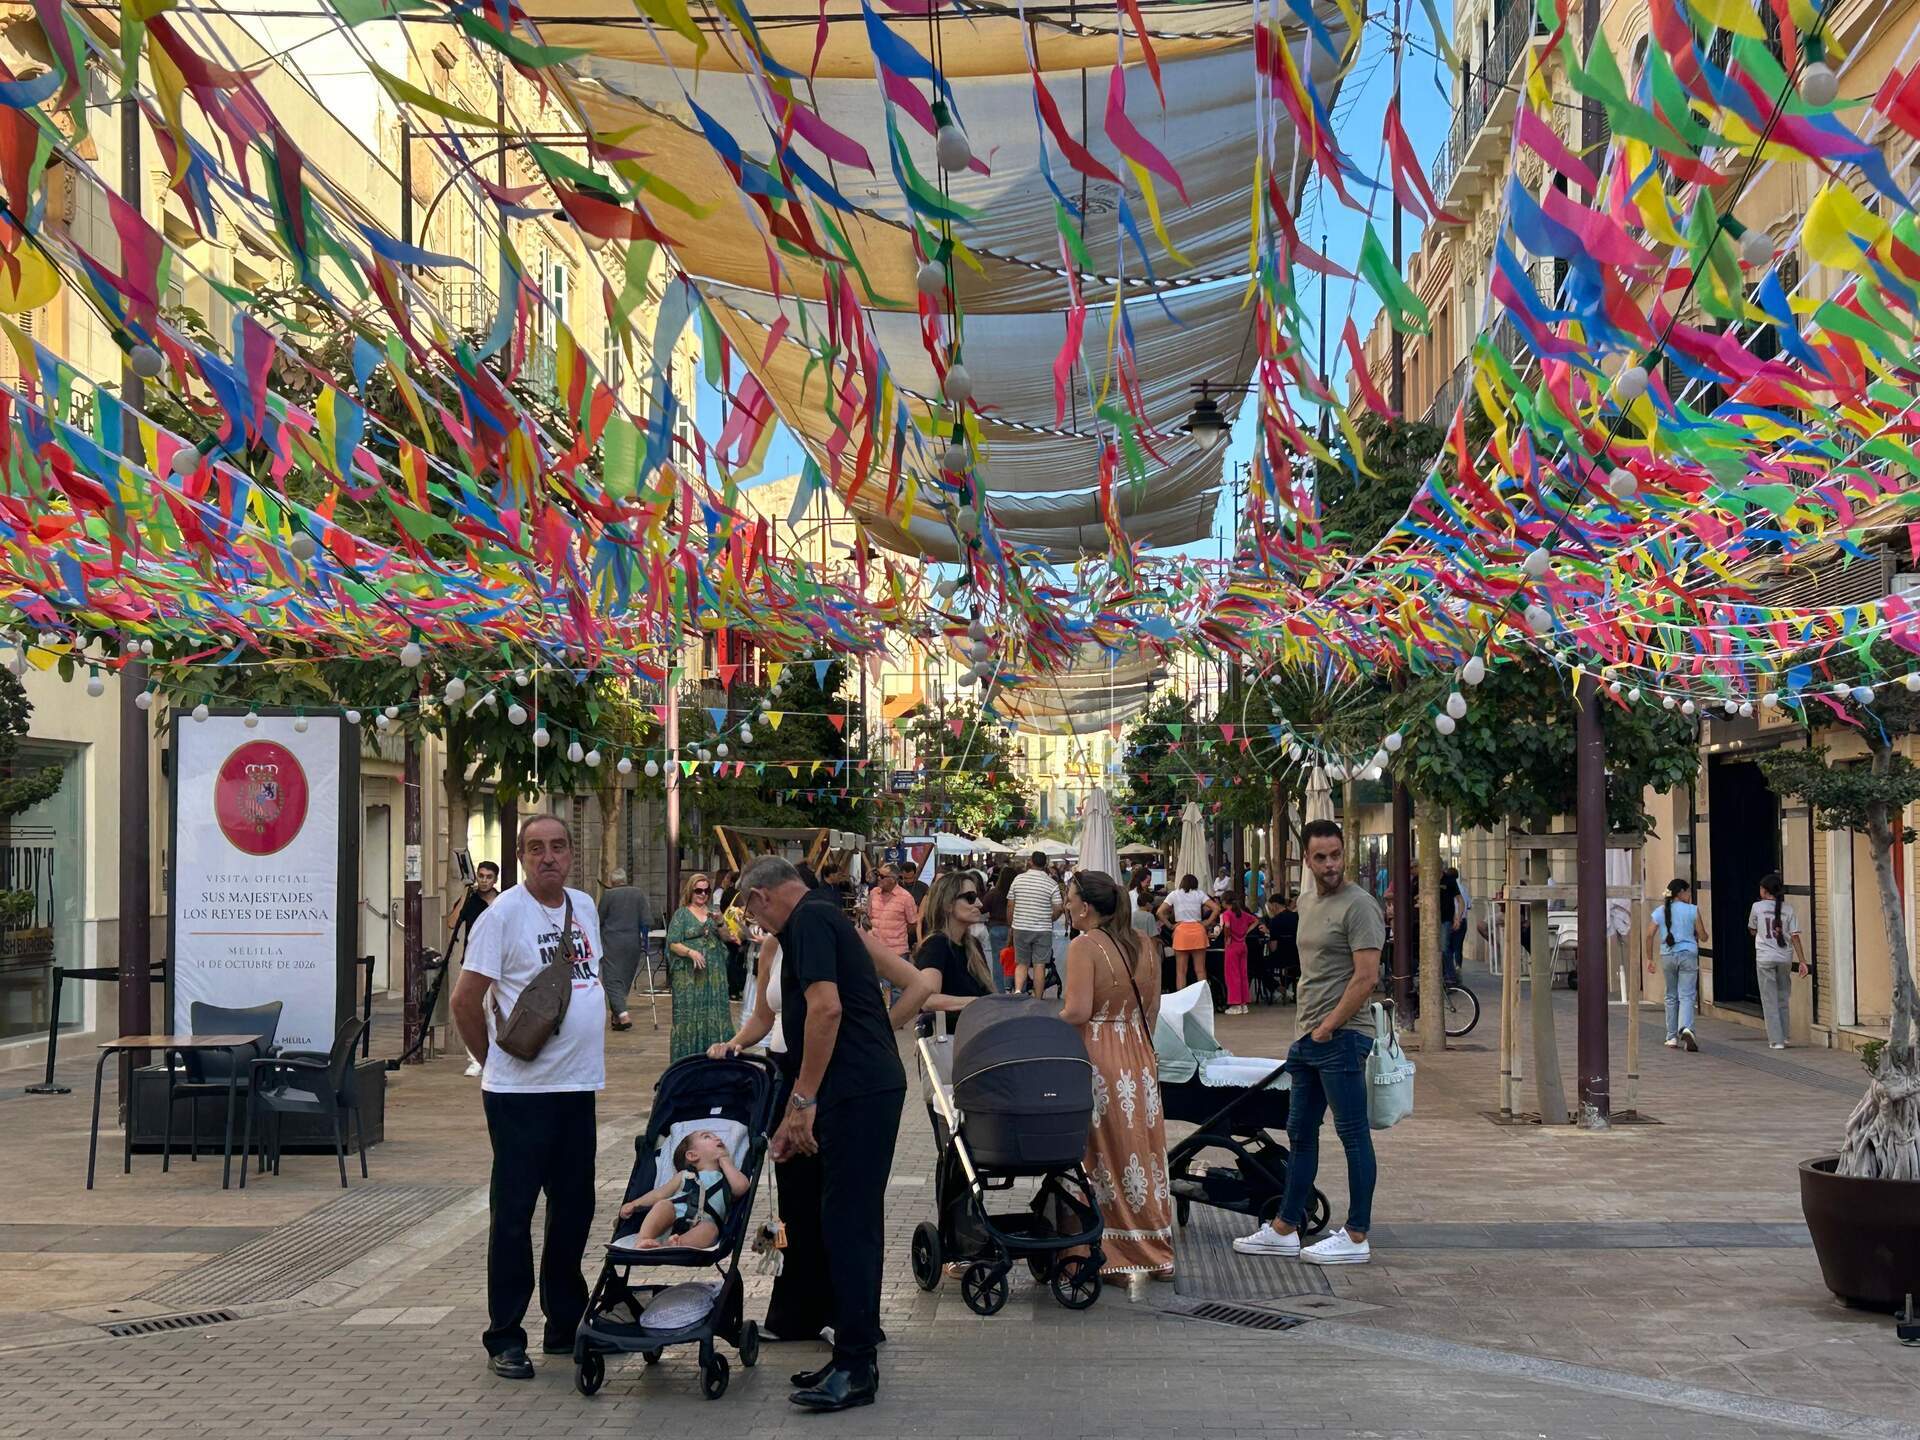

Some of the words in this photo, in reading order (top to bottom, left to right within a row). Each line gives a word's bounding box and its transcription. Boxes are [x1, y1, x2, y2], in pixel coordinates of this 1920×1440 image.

[206, 874, 248, 883] VISITA
[255, 874, 309, 883] OFICIAL
[201, 892, 225, 903] SUS
[228, 892, 313, 905] MAJESTADES
[183, 909, 207, 920] LOS
[211, 909, 251, 920] REYES
[255, 909, 271, 920] DE
[276, 908, 328, 920] ESPAÑA
[228, 947, 283, 955] MELILLA
[208, 960, 221, 969] DE
[224, 960, 273, 969] OCTUBRE
[276, 960, 290, 969] DE
[293, 960, 316, 969] 2026
